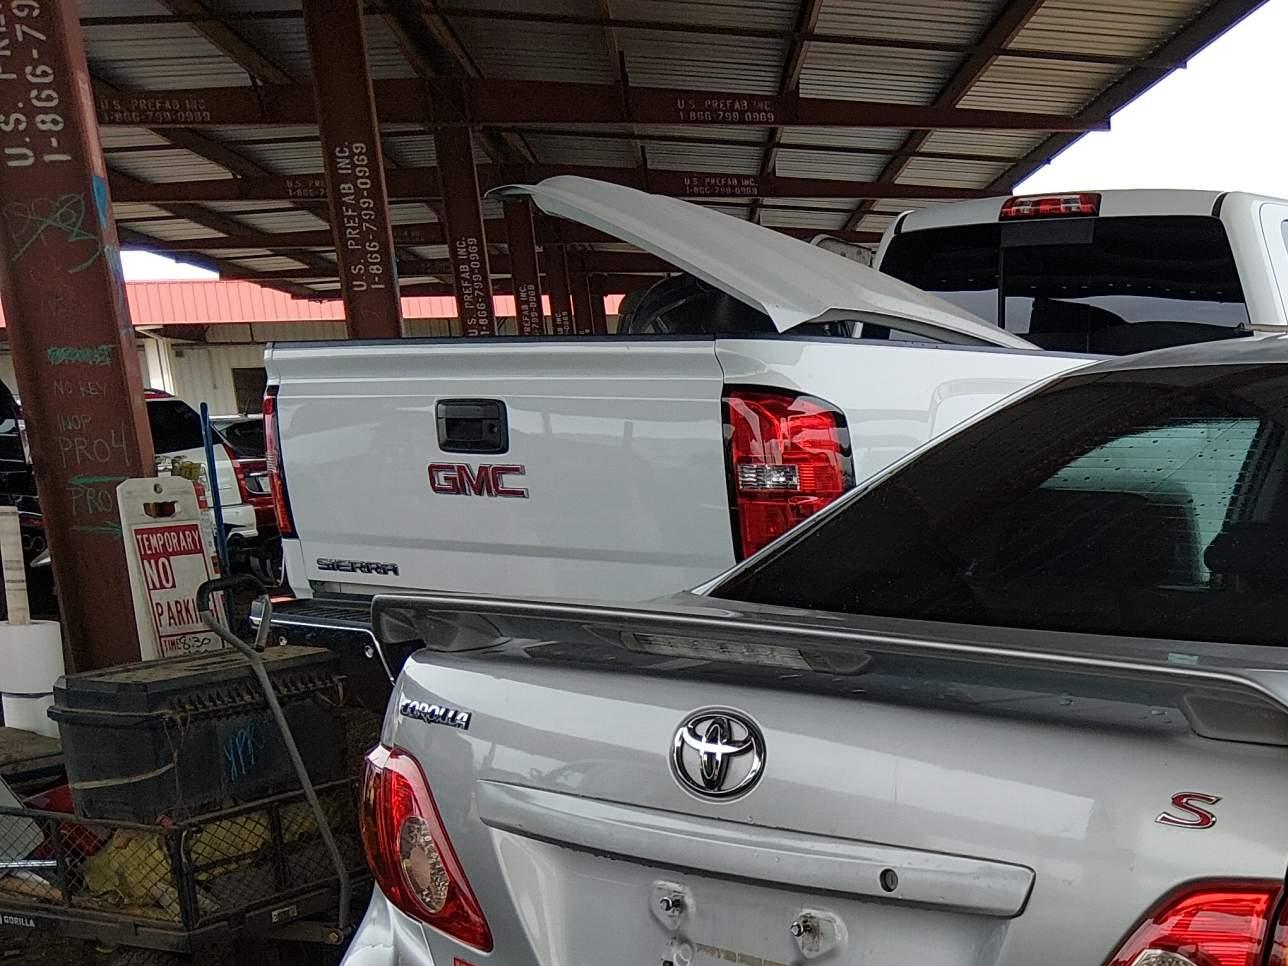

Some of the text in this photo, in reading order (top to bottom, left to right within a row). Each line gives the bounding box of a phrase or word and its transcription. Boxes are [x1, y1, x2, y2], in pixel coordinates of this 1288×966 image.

[704, 99, 748, 111] PREFAB
[335, 142, 367, 291] U.S. PREFAB INC.
[352, 143, 385, 289] 1-866-799-0969
[456, 236, 479, 336] U.S. PREFAB INC.
[428, 462, 530, 498] GMC
[136, 529, 200, 555] TEMPORARY
[143, 556, 174, 590] NO
[316, 557, 400, 577] SIERRA
[156, 597, 214, 628] PARKI
[400, 699, 472, 731] COROLLA
[1154, 791, 1224, 830] S
